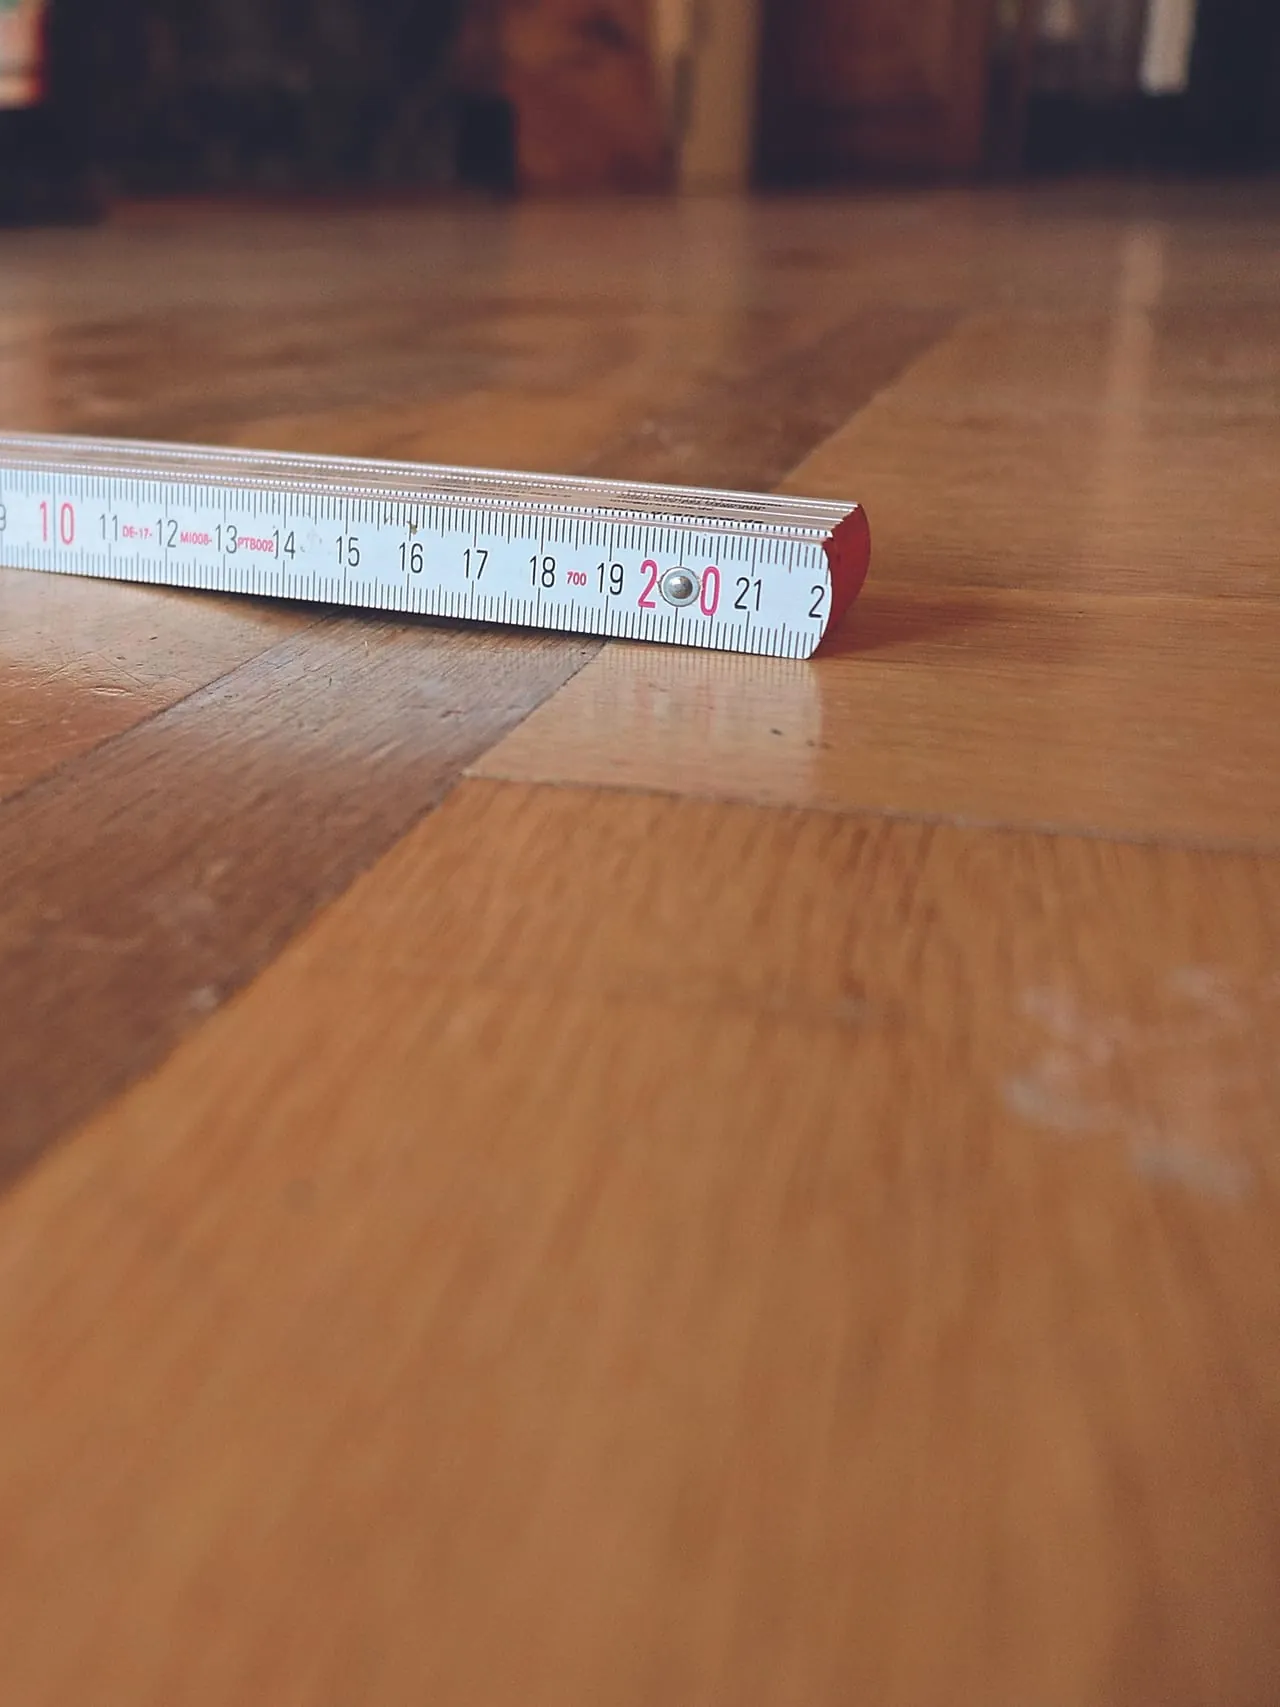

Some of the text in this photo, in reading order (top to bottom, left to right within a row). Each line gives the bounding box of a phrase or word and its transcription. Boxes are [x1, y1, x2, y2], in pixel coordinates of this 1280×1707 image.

[39, 500, 76, 546] 10
[99, 513, 120, 542] 11
[156, 518, 179, 548] 12
[215, 524, 238, 554] 13
[272, 529, 297, 560] 14
[336, 536, 361, 567] 15
[399, 542, 424, 574] 16
[463, 548, 489, 580] 17
[529, 555, 556, 588] 18
[597, 562, 625, 595] 19
[734, 577, 763, 612] 21
[567, 571, 587, 586] 700
